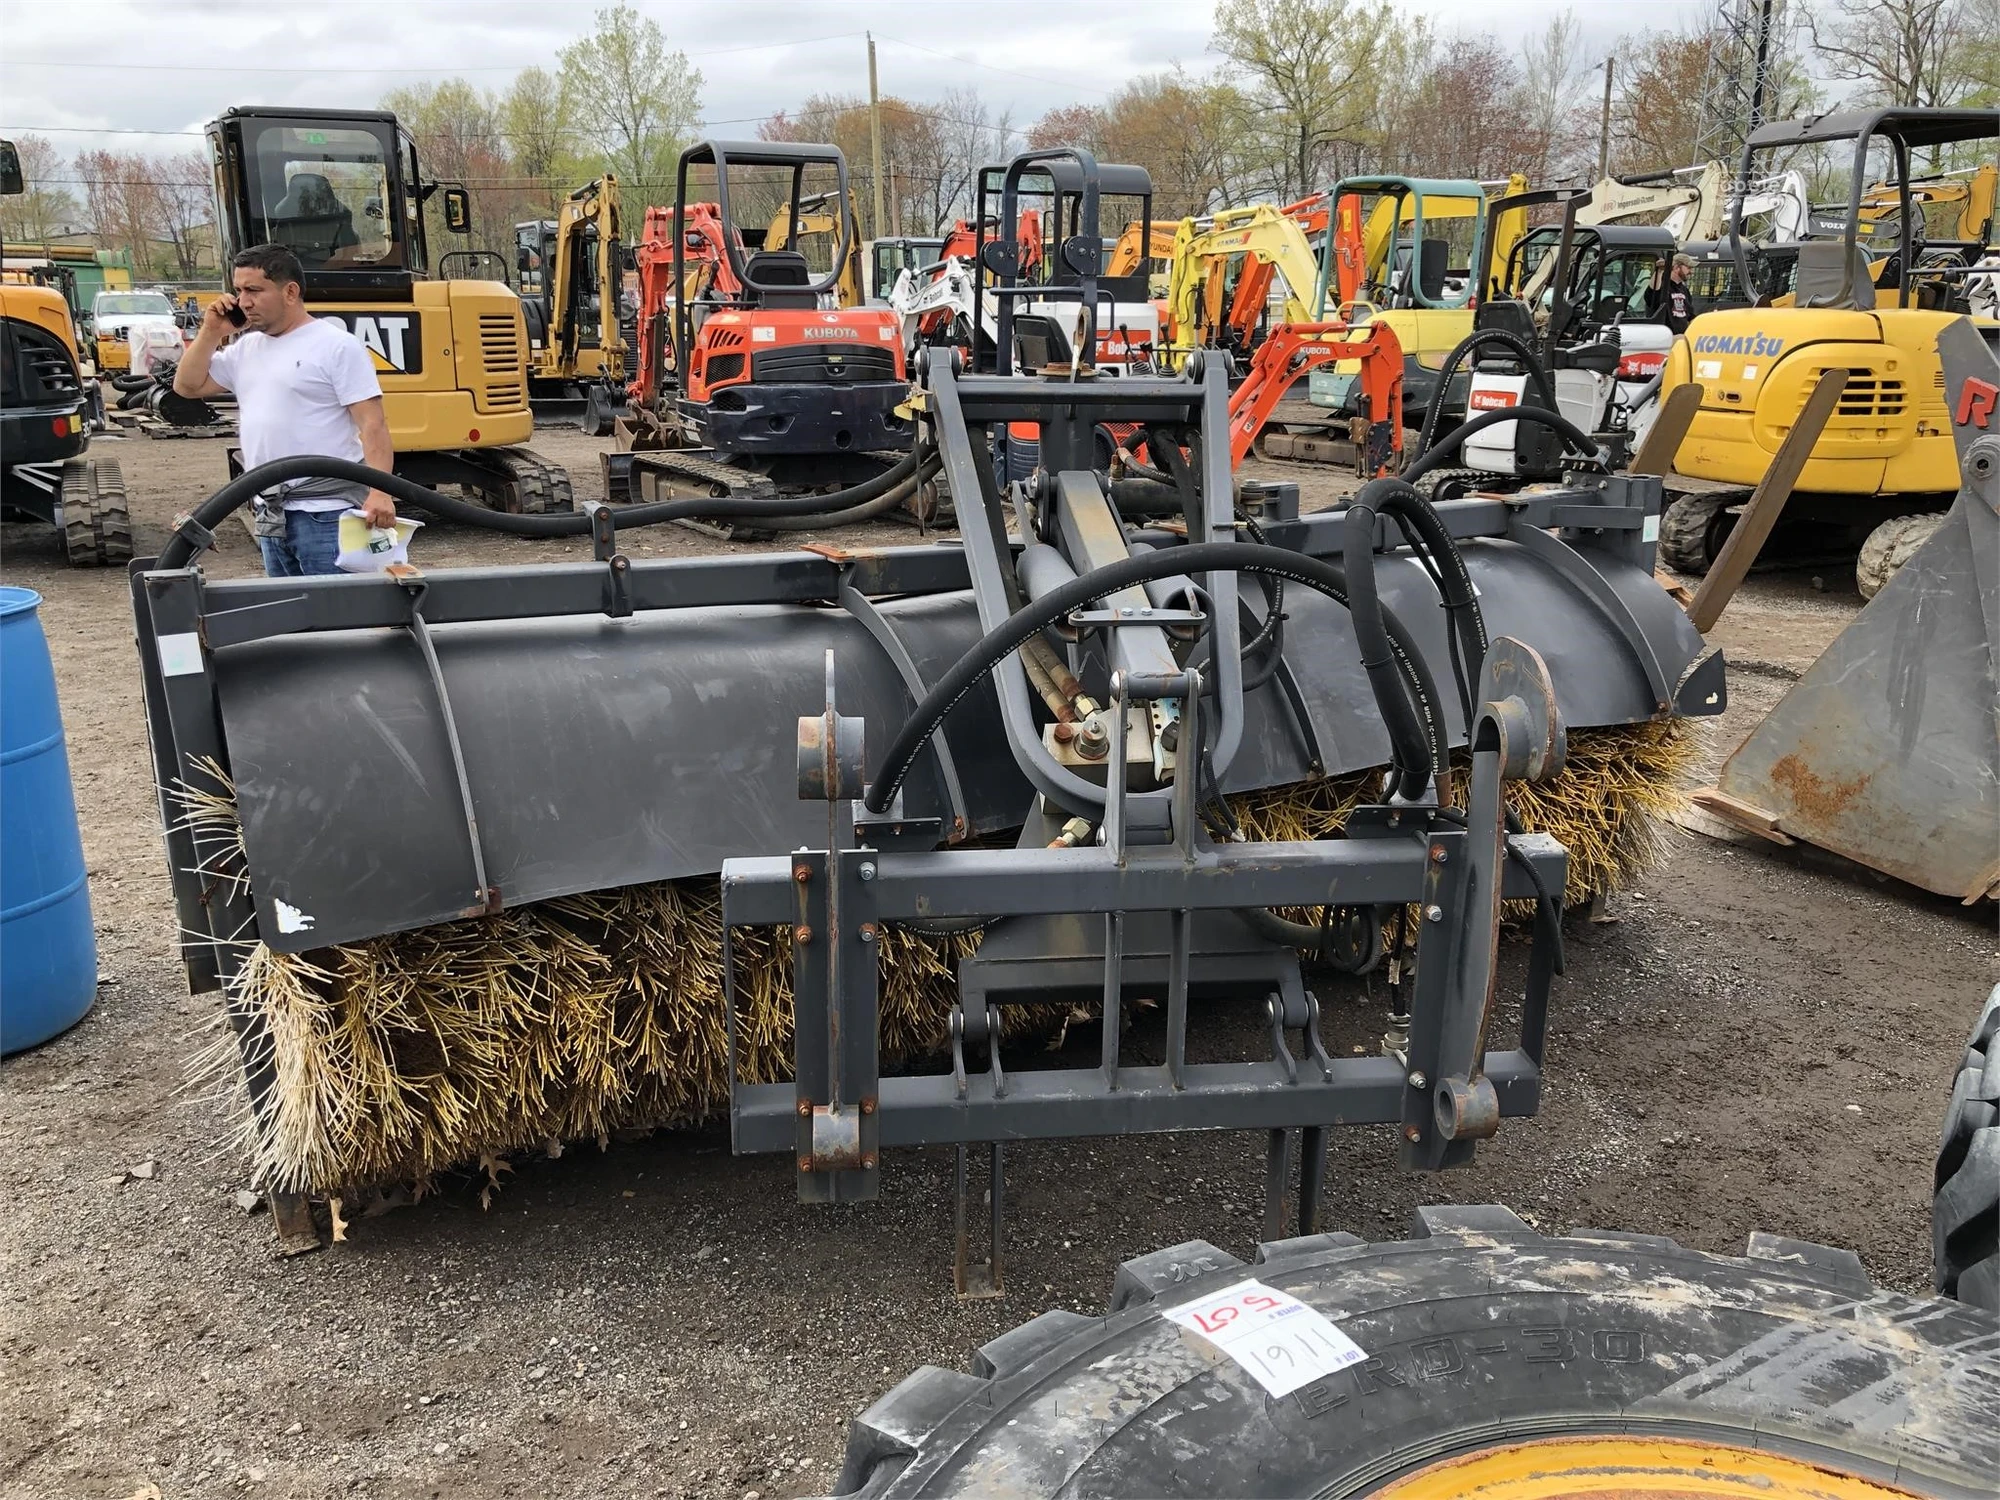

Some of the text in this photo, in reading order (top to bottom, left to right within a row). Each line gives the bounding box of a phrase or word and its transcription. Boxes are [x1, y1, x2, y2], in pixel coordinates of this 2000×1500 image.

[1820, 221, 1847, 230] VOLV
[1150, 242, 1173, 255] YUNDAI
[803, 327, 859, 339] KUBOTA
[322, 316, 409, 370] AT
[1694, 331, 1783, 357] KOMATSU
[1300, 346, 1330, 356] KUBOTA
[1345, 1350, 1360, 1362] LOT
